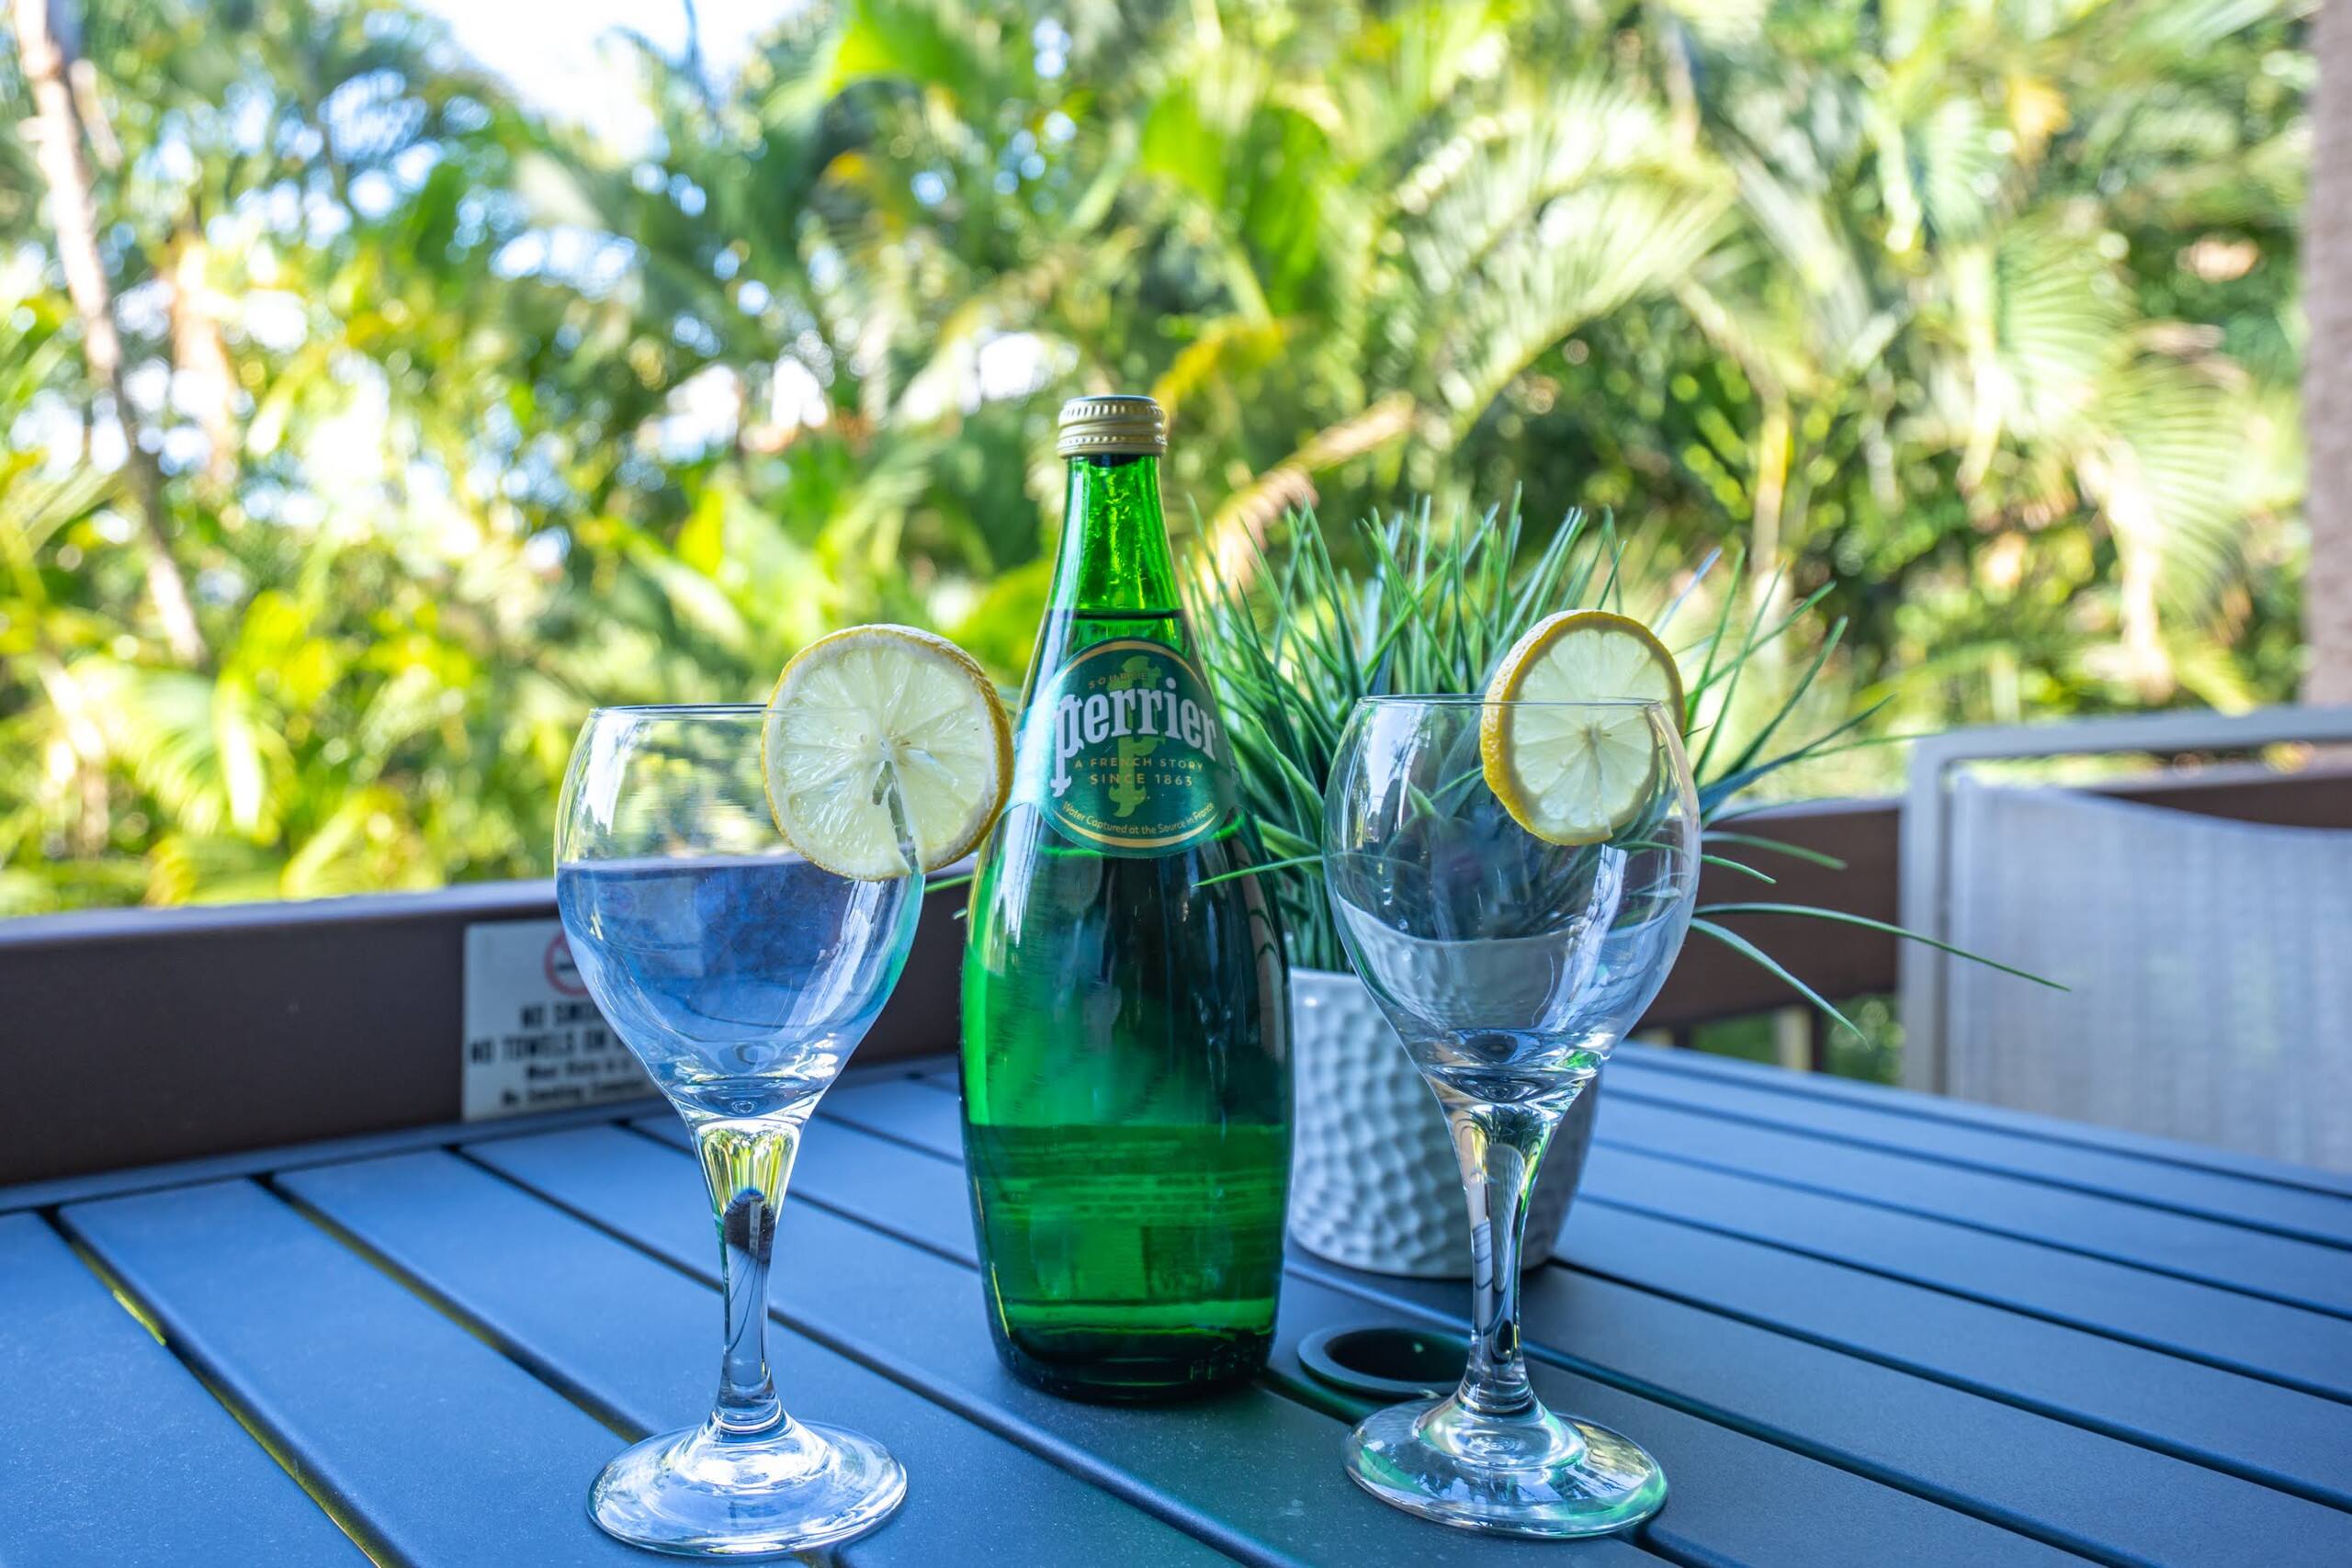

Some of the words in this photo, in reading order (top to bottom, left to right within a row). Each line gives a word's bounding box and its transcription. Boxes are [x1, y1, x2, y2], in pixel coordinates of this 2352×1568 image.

[1088, 671, 1148, 689] SOURCE
[1050, 677, 1216, 797] perrier
[1074, 759, 1083, 769] A
[1091, 757, 1152, 769] FRENCH
[1159, 758, 1204, 772] STORY
[1090, 773, 1146, 785] SINCE
[1062, 800, 1086, 820] Water
[1086, 816, 1127, 833] Captured
[1128, 826, 1139, 835] at
[1141, 825, 1157, 834] the
[1158, 820, 1187, 833] Source
[1193, 801, 1215, 822] France
[521, 1006, 544, 1028] NO
[471, 1040, 492, 1063] NO
